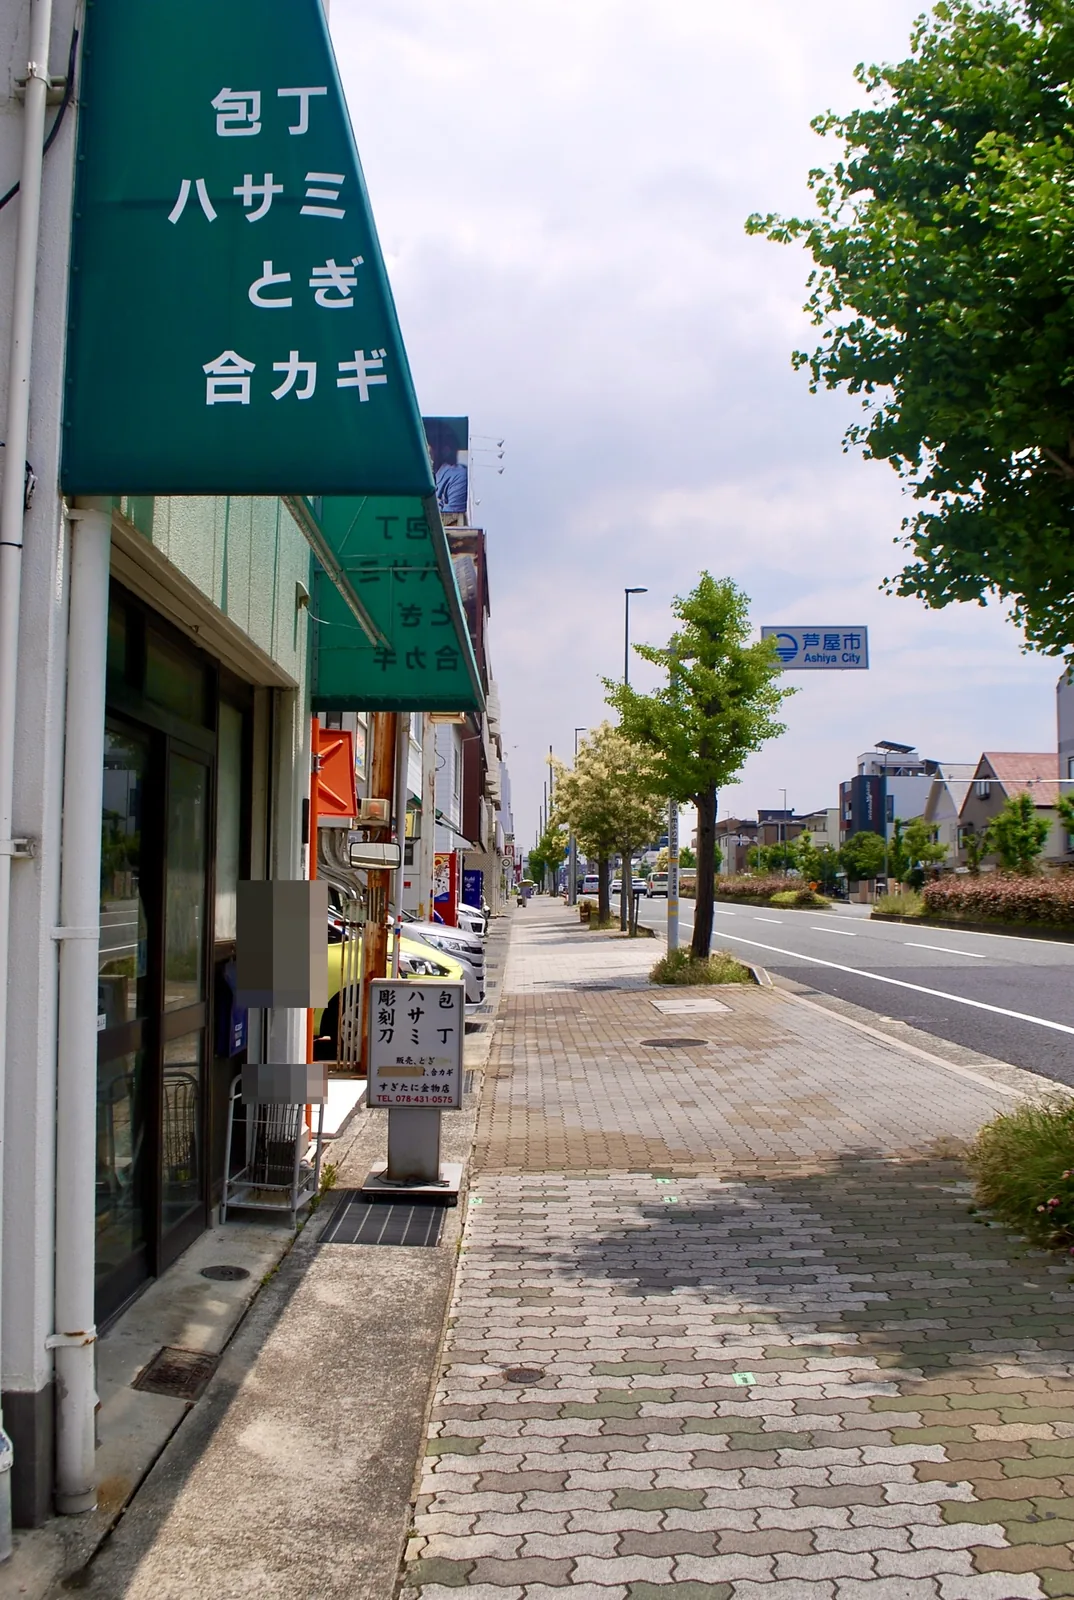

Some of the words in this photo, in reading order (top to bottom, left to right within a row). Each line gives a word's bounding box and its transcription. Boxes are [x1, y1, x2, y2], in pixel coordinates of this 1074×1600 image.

[210, 86, 328, 137] 包丁
[167, 171, 346, 224] ハサミ
[247, 255, 364, 308] とぎ
[202, 348, 388, 405] 合カギ
[802, 633, 861, 651] 芦屋市
[804, 653, 837, 664] Ashiya
[841, 652, 861, 664] City
[377, 989, 396, 1044] 彫刻刀
[408, 991, 424, 1045] ハサミ
[436, 990, 454, 1044] 包丁
[376, 1094, 392, 1103] TEL
[379, 1083, 450, 1093] すぎたに金物店
